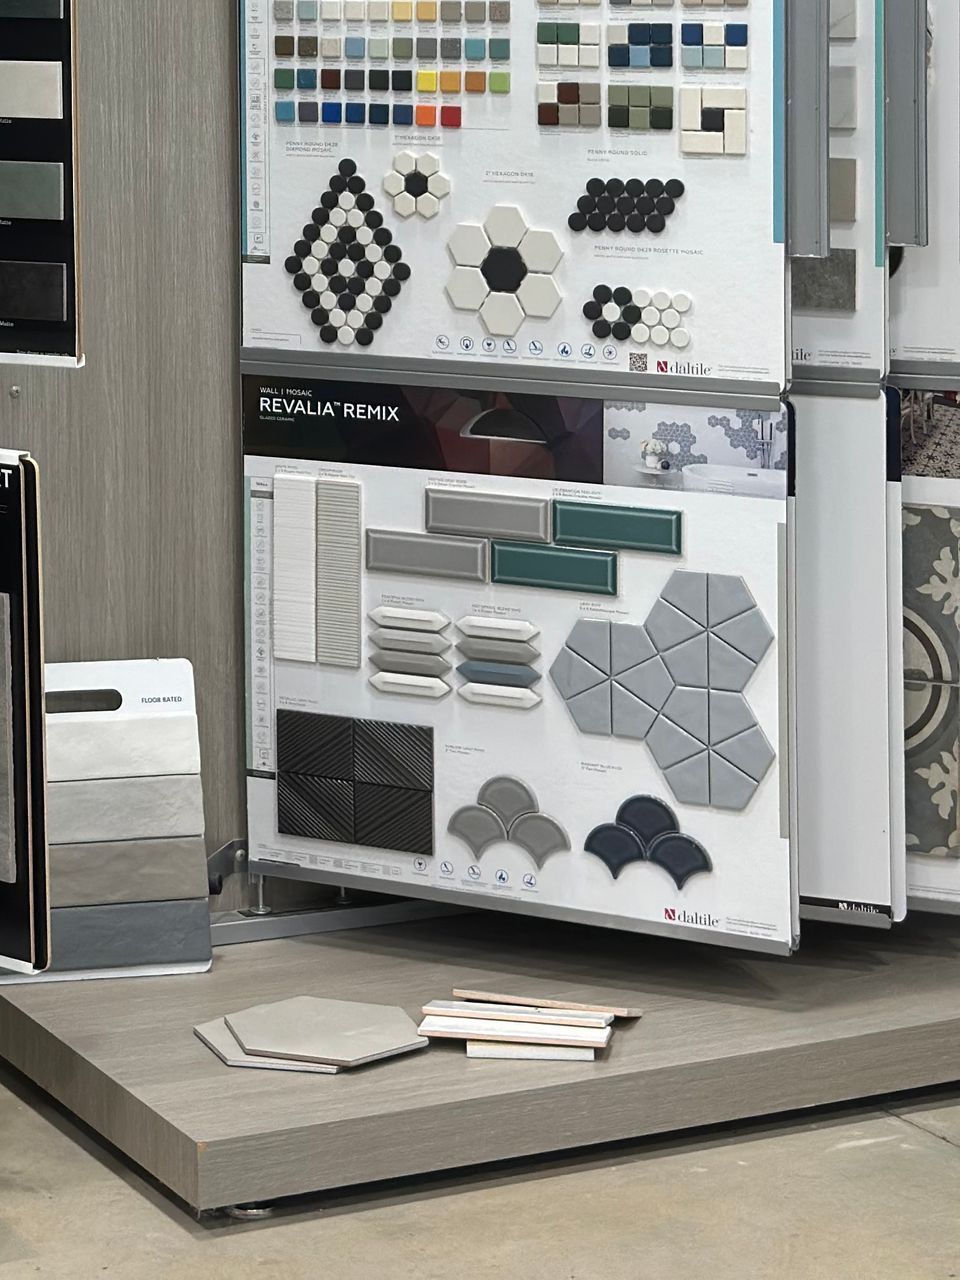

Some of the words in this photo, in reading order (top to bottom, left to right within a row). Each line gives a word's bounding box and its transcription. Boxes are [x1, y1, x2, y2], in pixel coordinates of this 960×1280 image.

[669, 360, 712, 377] daltile
[260, 387, 279, 395] WALL
[286, 389, 312, 397] MOSAIC
[344, 403, 399, 422] REMIX
[677, 910, 720, 928] daltile
